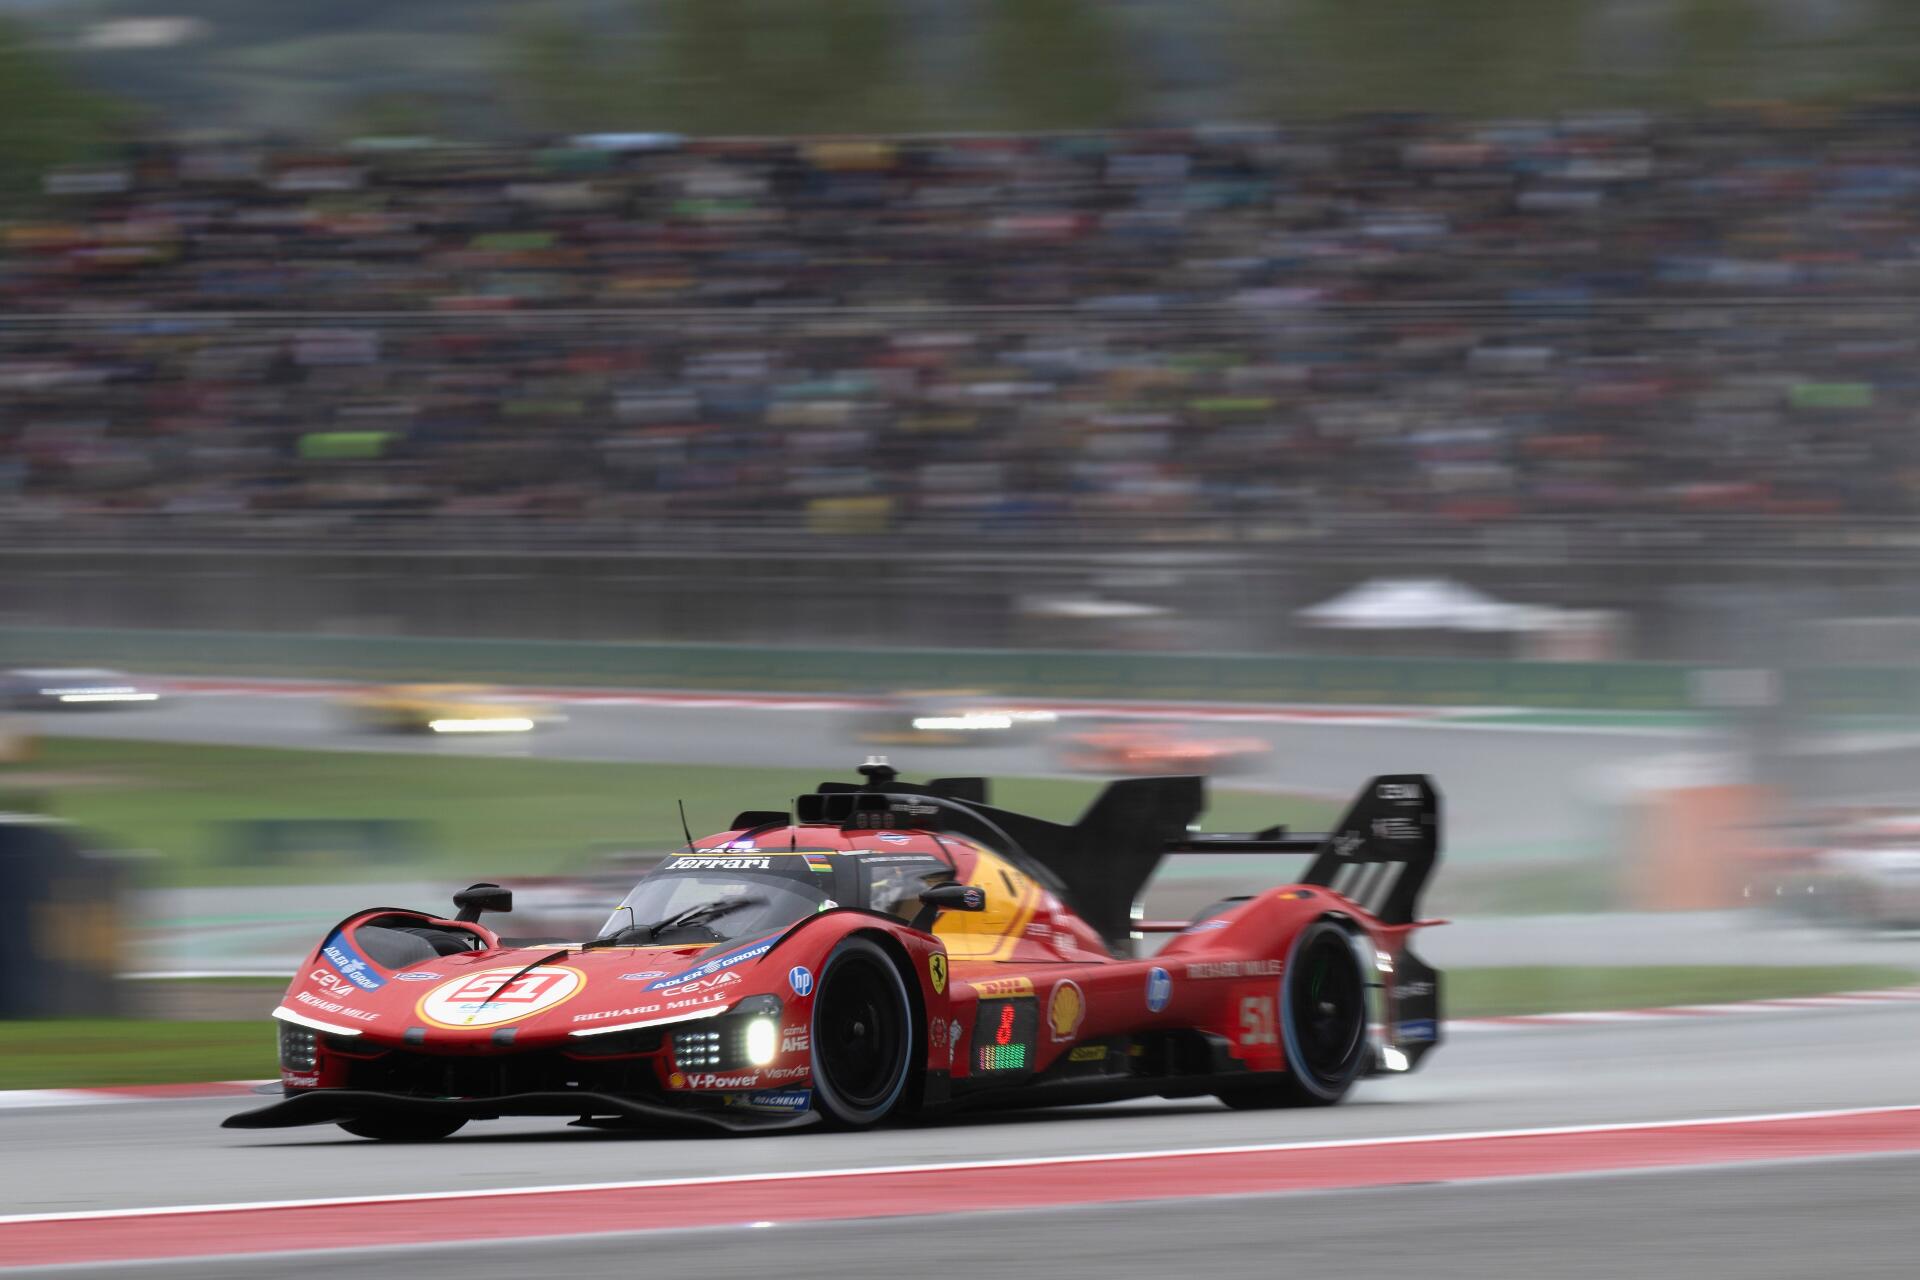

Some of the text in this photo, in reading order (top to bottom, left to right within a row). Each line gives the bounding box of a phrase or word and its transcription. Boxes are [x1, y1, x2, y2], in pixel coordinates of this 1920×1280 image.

[665, 856, 772, 869] Ferrari
[323, 946, 350, 967] ADLER
[652, 971, 703, 990] ADLER
[722, 945, 771, 967] GROUP
[451, 975, 552, 999] 51
[295, 991, 343, 1014] RICHARD
[340, 1006, 381, 1021] MILLE
[573, 992, 727, 1023] RICHARD MILLE
[1240, 995, 1278, 1045] 51
[687, 1075, 759, 1088] V-Power
[753, 1095, 805, 1106] MICHELIN
